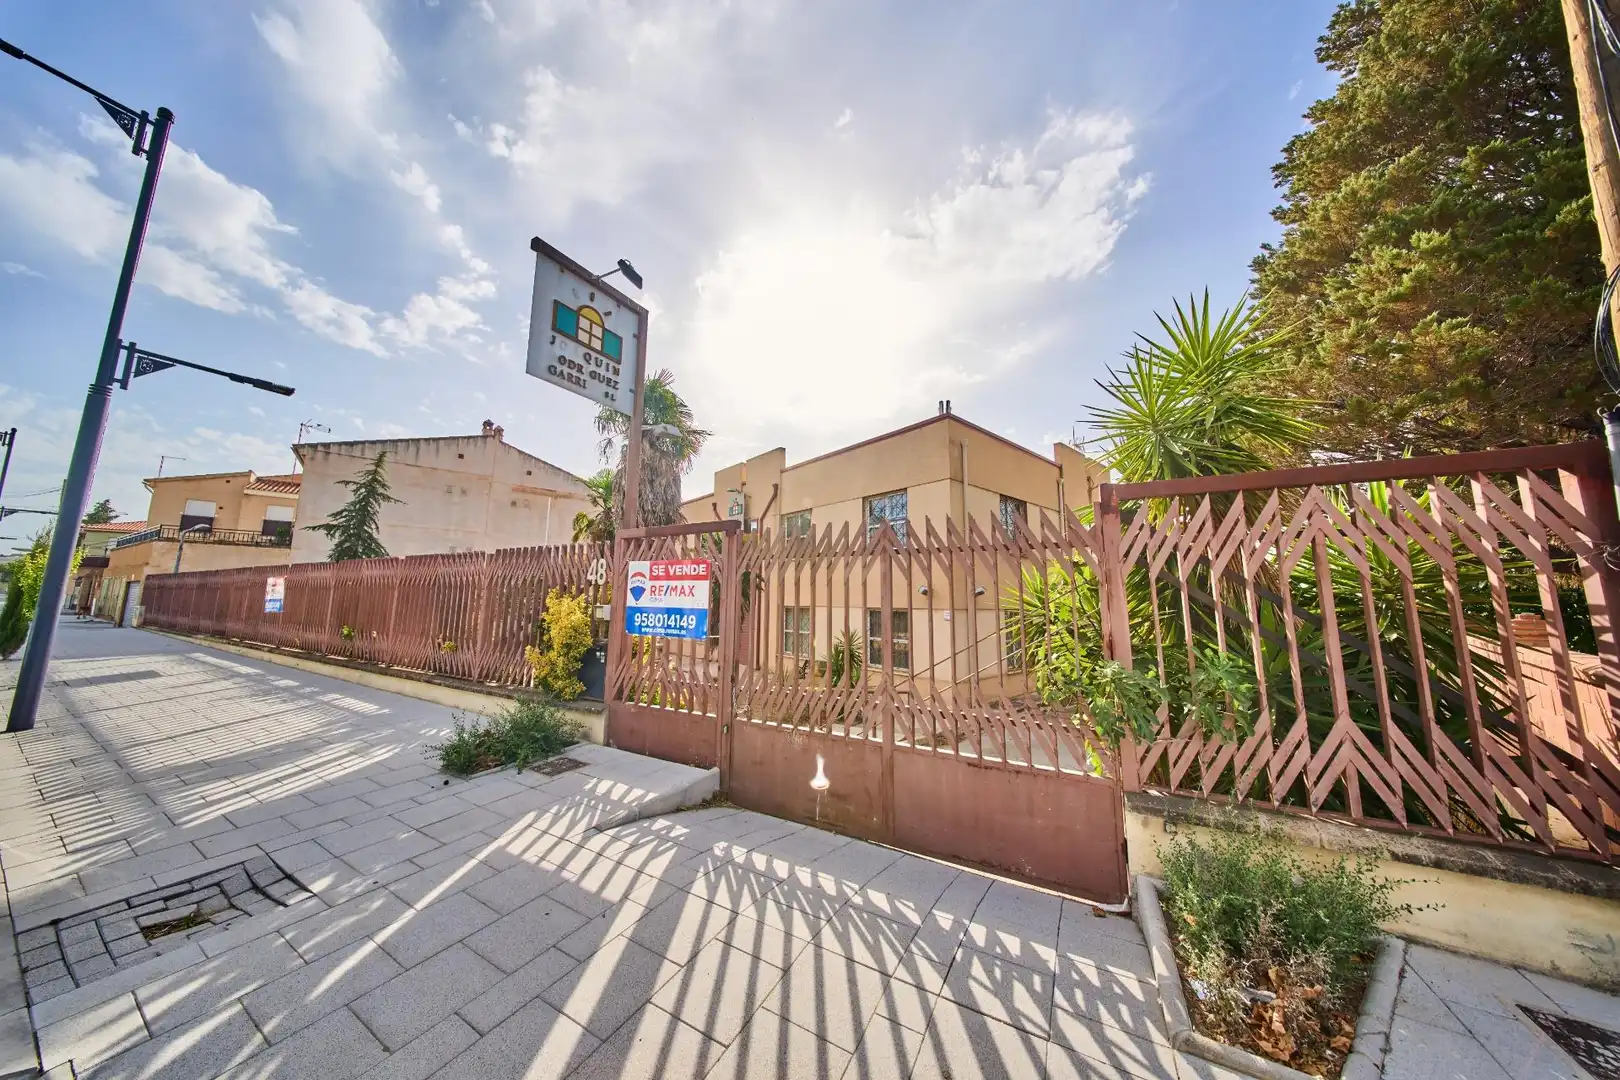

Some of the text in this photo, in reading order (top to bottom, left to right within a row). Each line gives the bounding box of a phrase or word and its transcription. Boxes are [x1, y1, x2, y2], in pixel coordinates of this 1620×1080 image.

[587, 559, 606, 585] 48
[652, 564, 707, 576] SE VENDE
[650, 585, 695, 597] RE/MAX
[634, 613, 696, 629] 958014149
